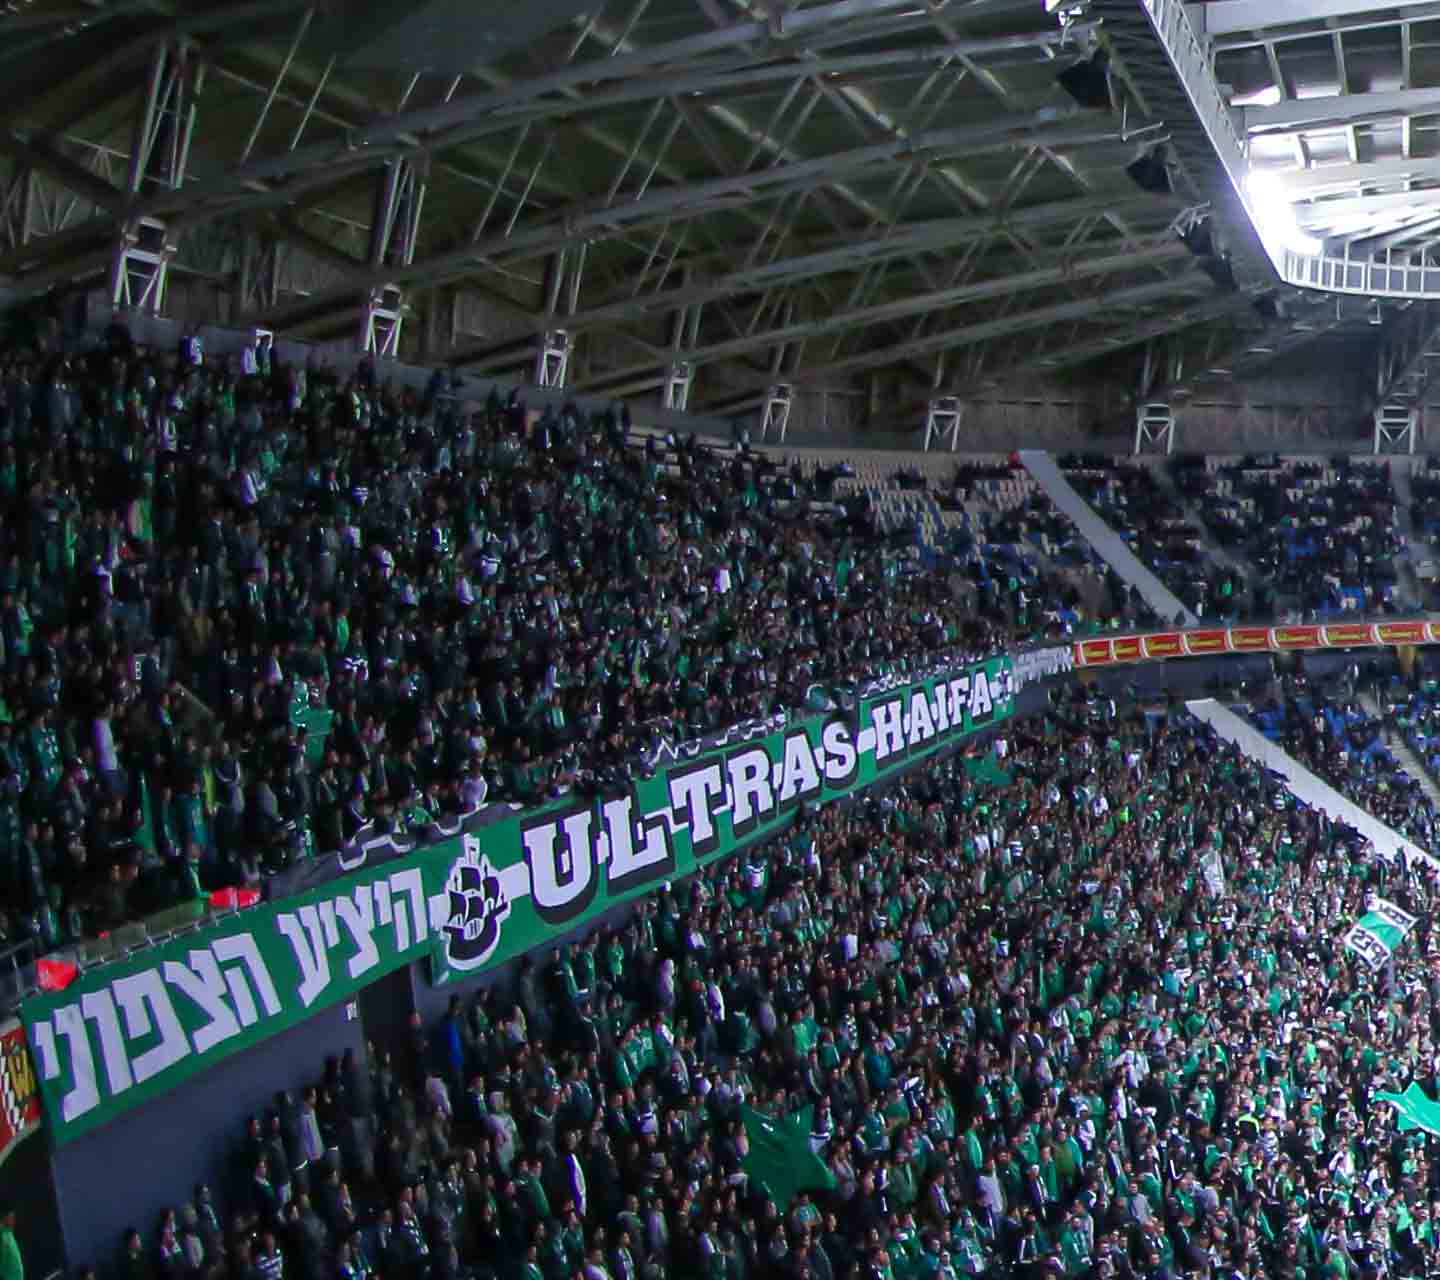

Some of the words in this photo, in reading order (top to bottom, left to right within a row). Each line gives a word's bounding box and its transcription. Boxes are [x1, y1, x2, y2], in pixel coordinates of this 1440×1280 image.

[520, 720, 860, 910] ULTRAS
[869, 671, 993, 760] HAIFA
[32, 932, 281, 1124] הצפוני
[277, 867, 429, 1009] היציע
